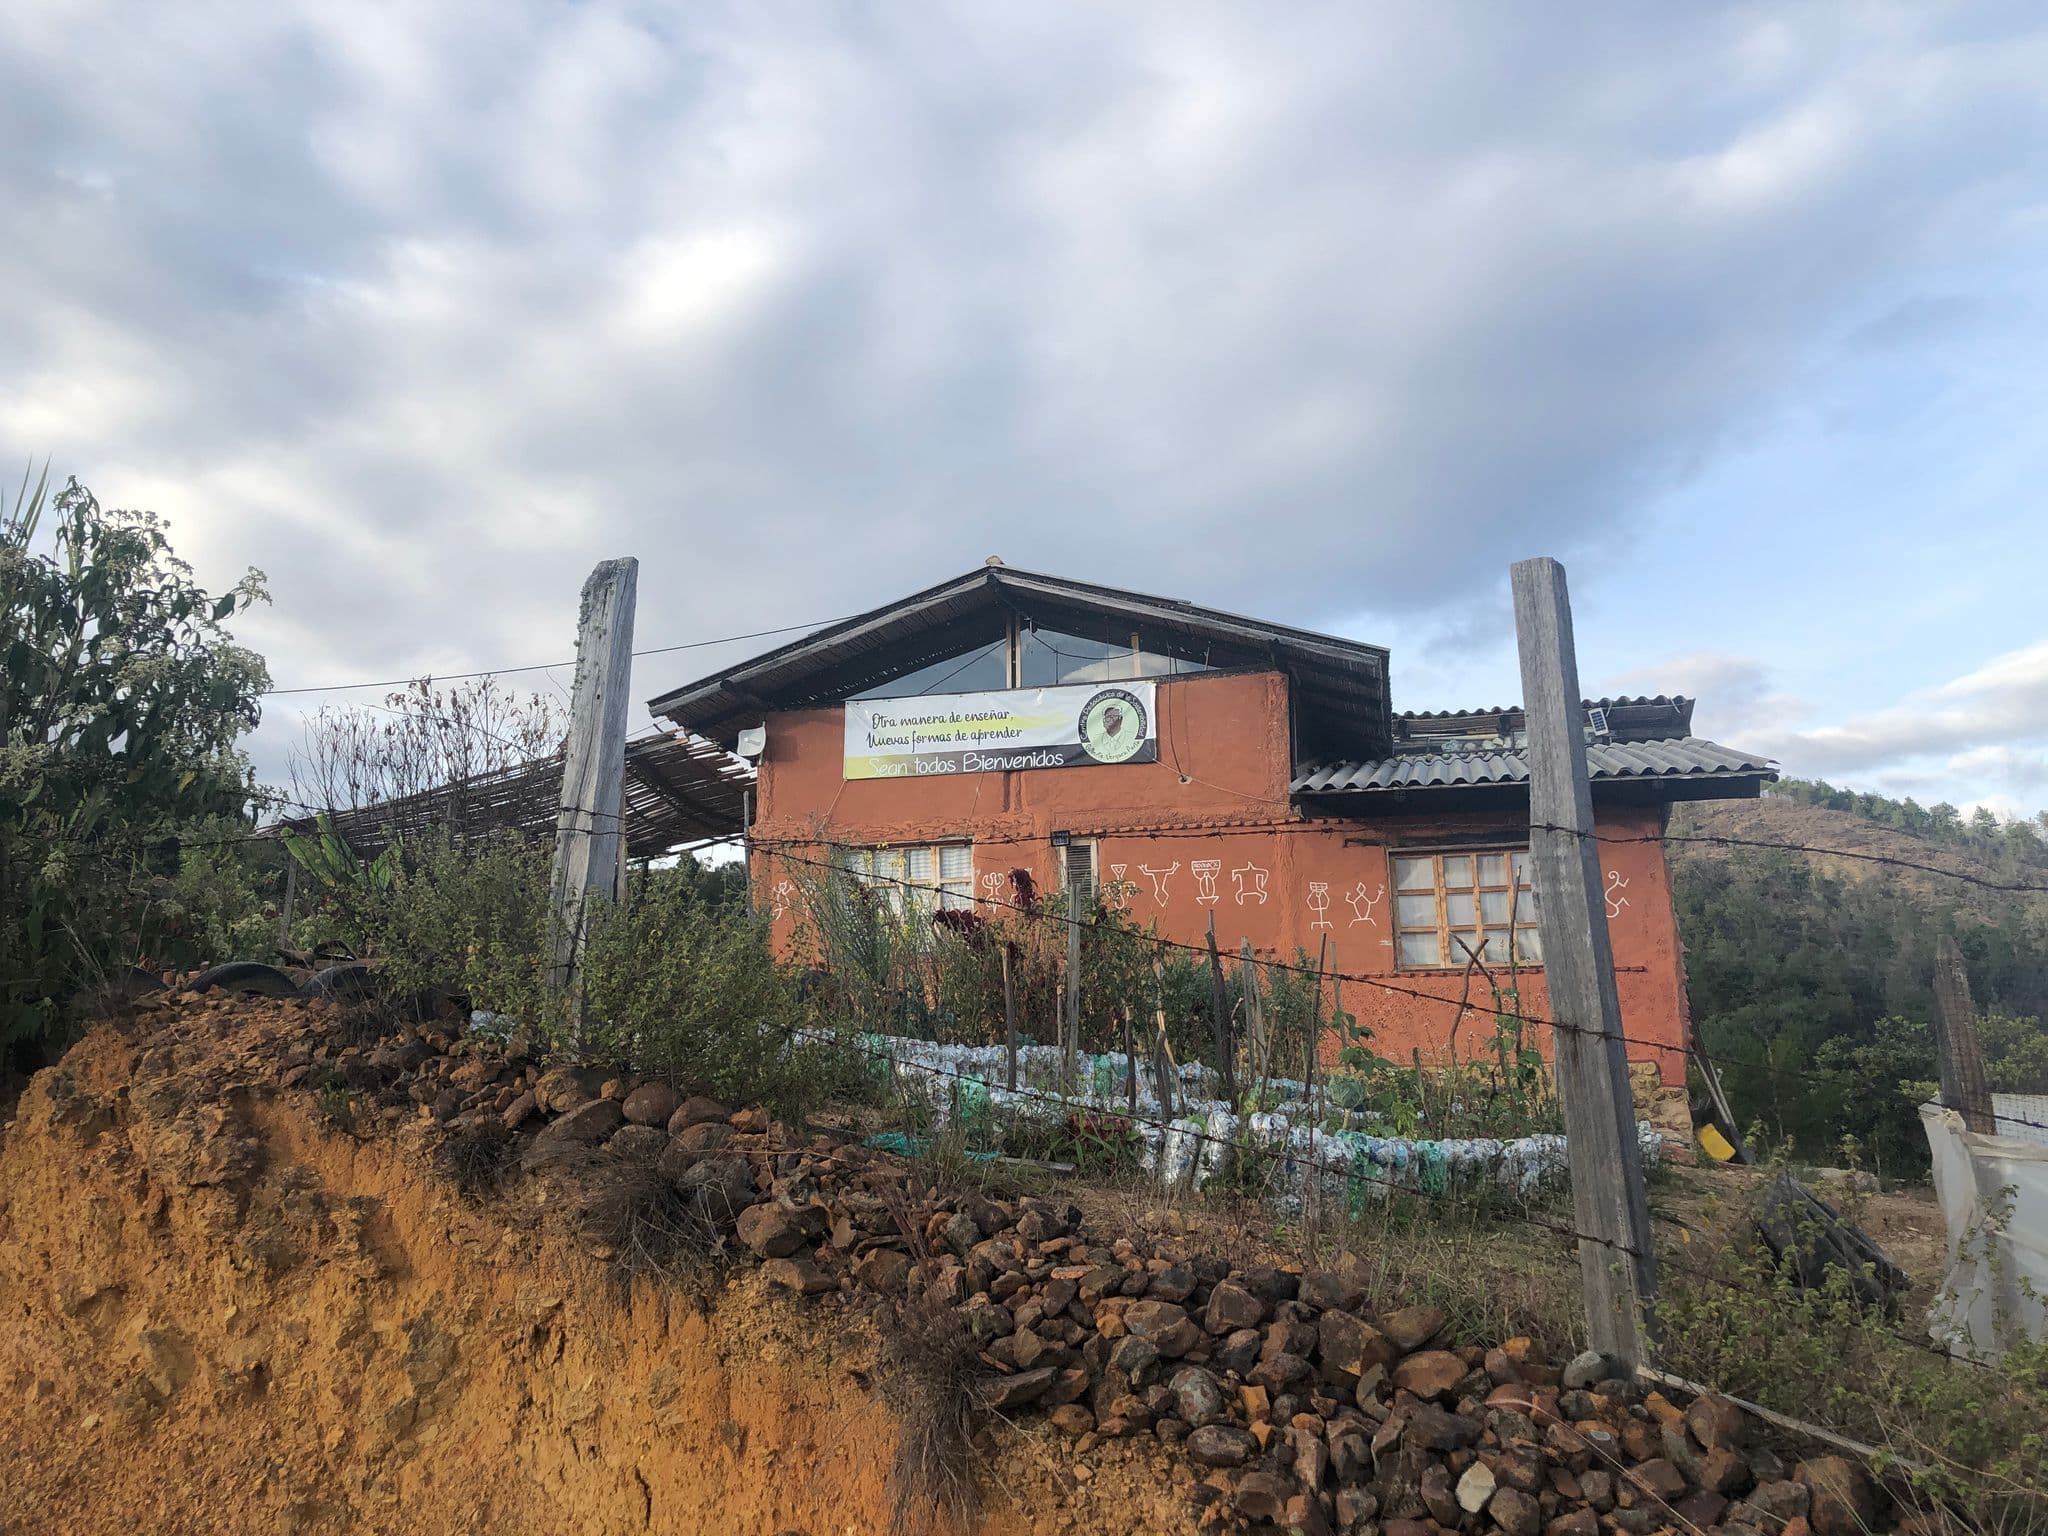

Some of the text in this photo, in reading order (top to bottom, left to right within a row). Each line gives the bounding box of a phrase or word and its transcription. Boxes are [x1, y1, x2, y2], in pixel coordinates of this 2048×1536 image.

[872, 709, 1014, 730] Otra manera de enseñar,
[866, 726, 1023, 753] Nuevas formas de aprender
[868, 749, 1065, 776] Sean todos Bienvenidos
